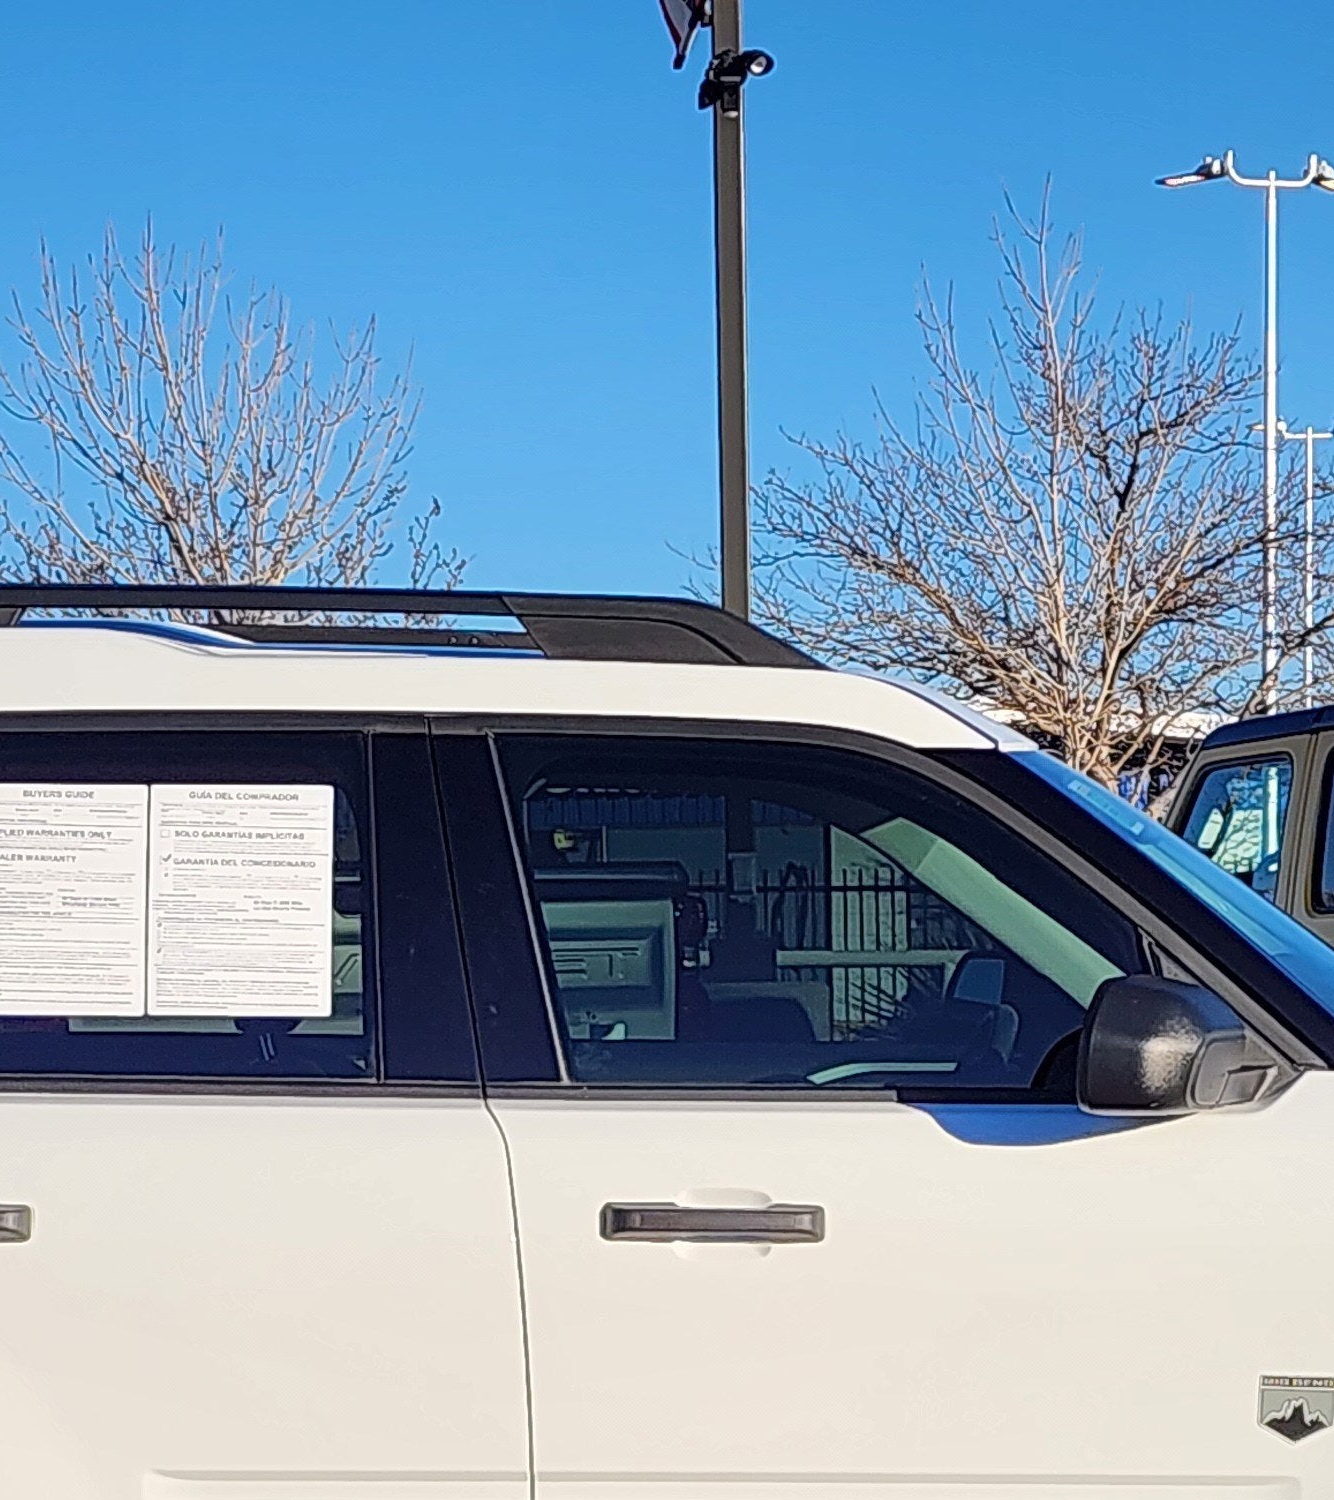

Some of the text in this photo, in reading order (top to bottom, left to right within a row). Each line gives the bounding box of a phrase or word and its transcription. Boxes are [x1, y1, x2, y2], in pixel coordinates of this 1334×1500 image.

[22, 789, 94, 799] BUYERS GUIDE
[215, 792, 232, 800] DEL
[236, 792, 299, 801] COMPRADOR
[26, 854, 76, 863] WARRANTY
